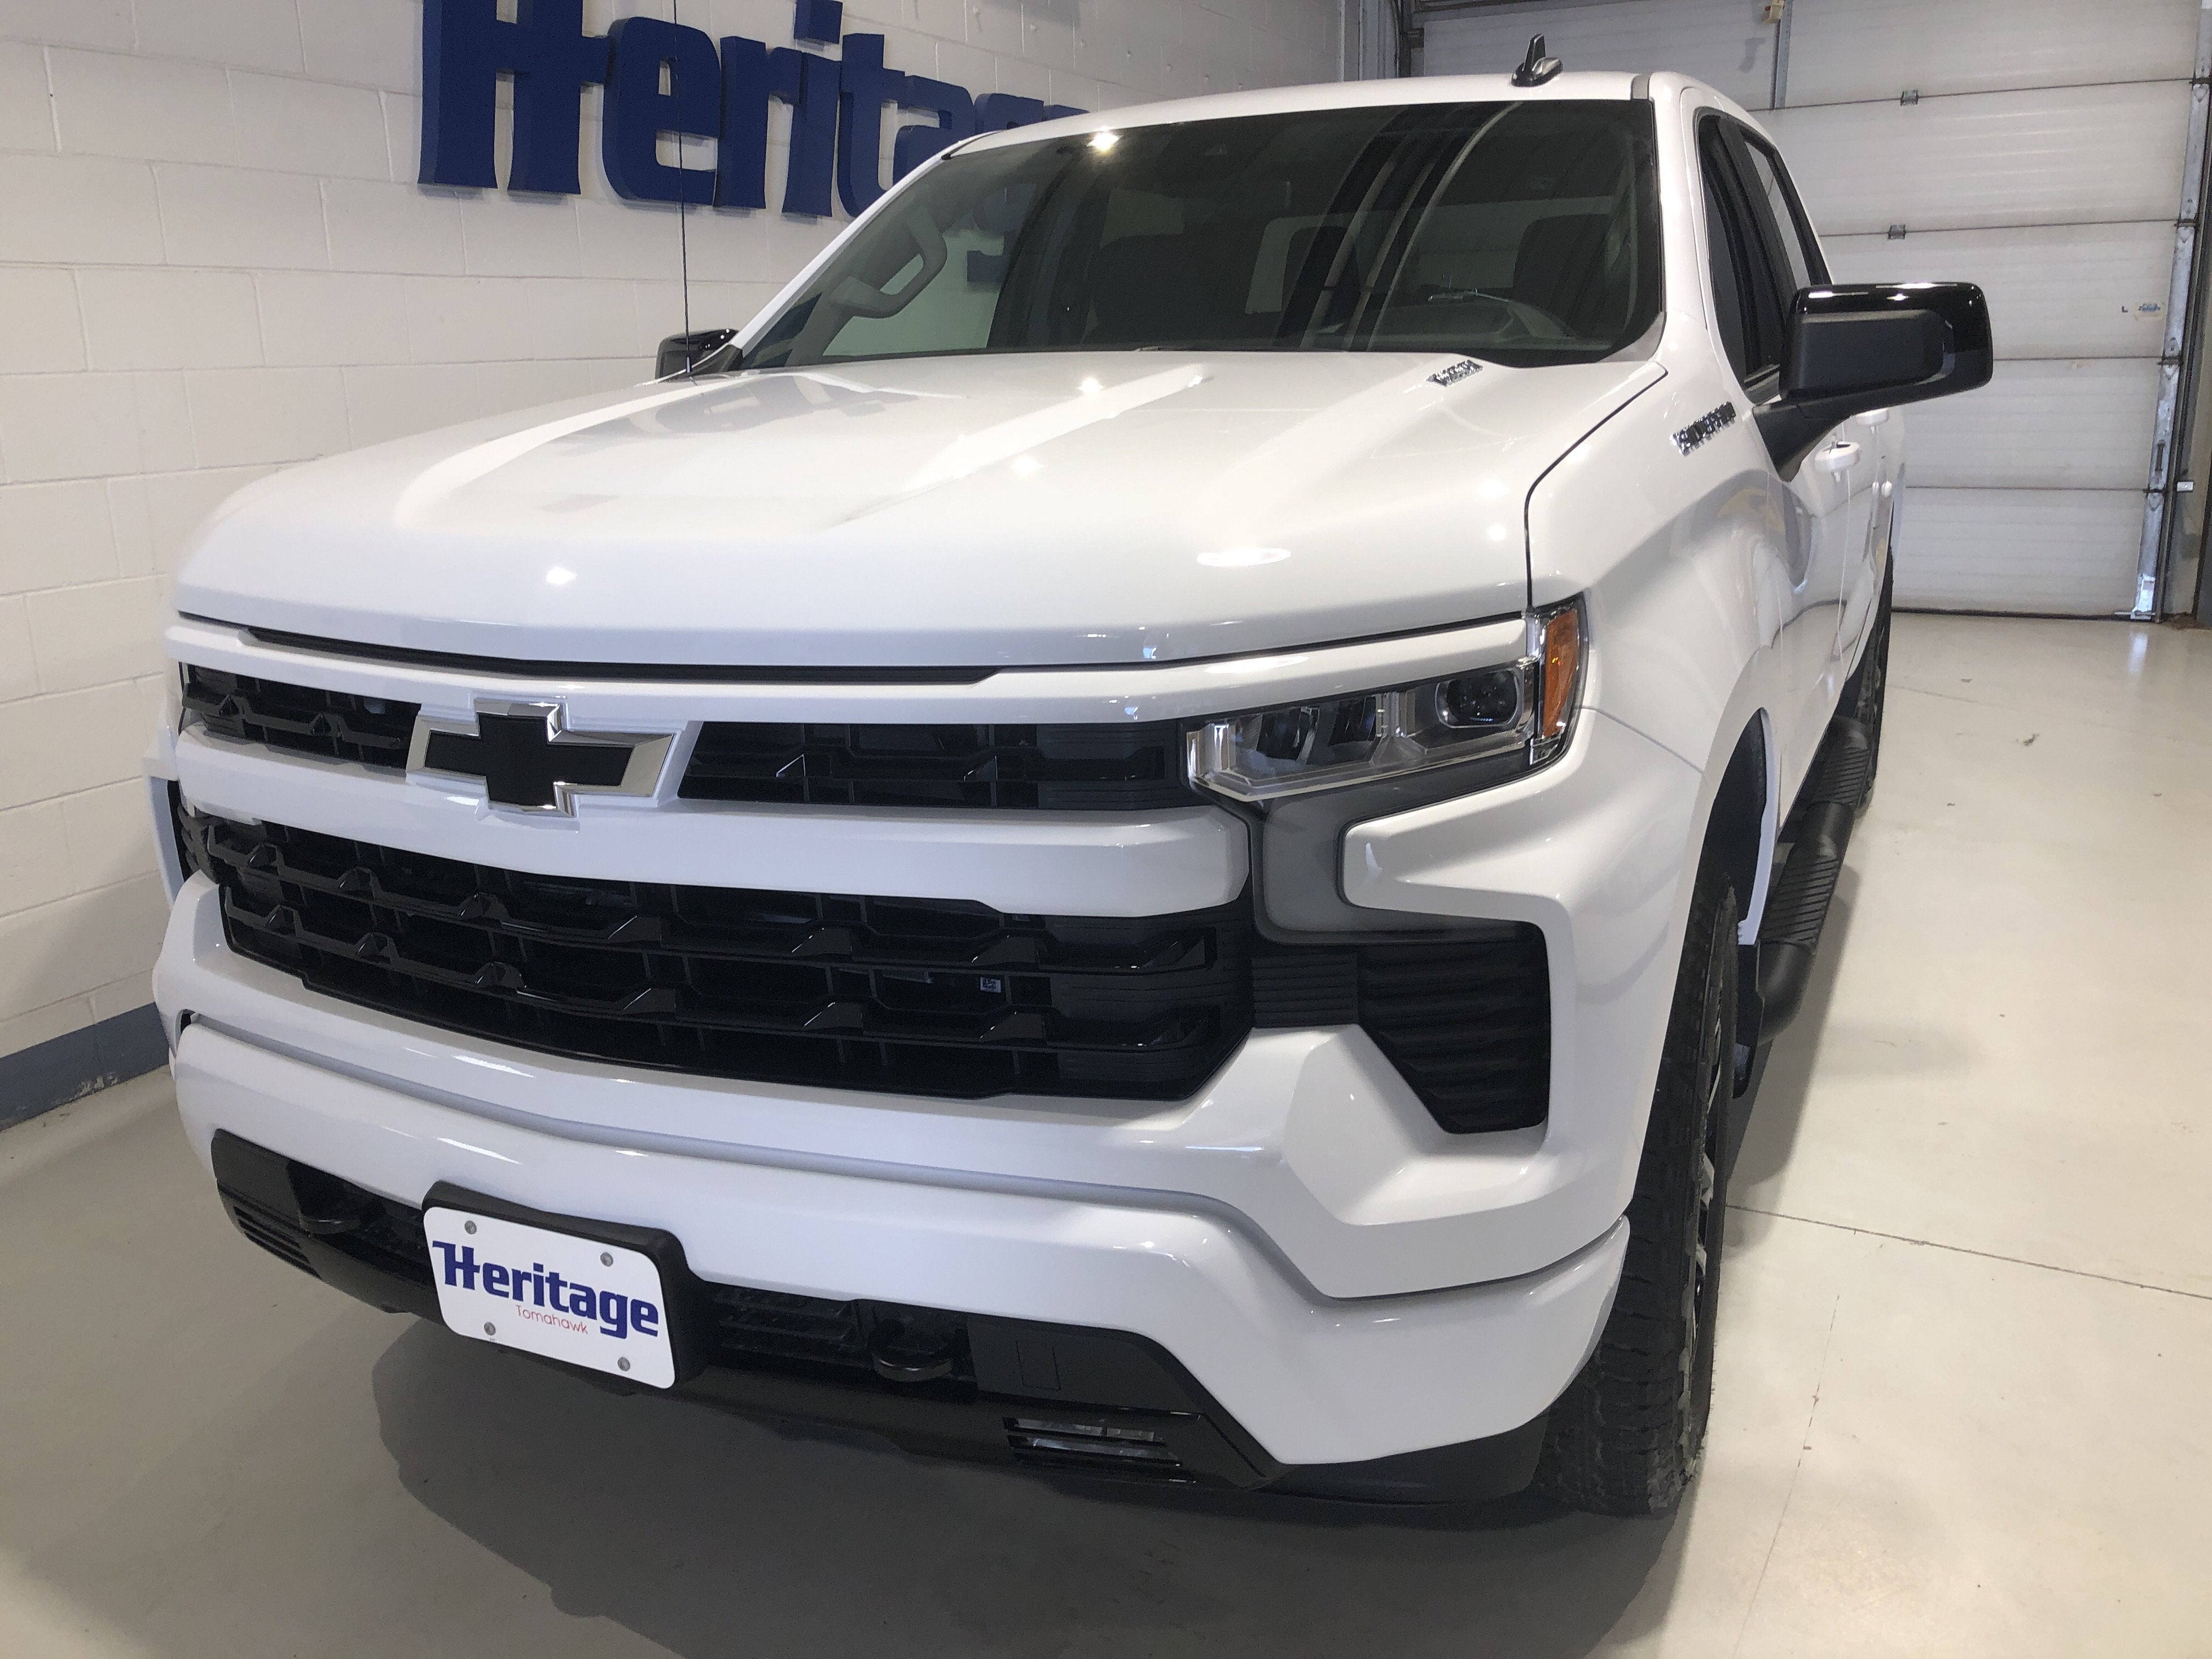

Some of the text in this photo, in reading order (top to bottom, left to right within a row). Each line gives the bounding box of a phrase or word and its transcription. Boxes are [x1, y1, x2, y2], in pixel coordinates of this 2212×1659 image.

[418, 0, 1090, 218] Herita
[432, 1240, 659, 1339] Heritage
[515, 1304, 588, 1334] Tomahawk
